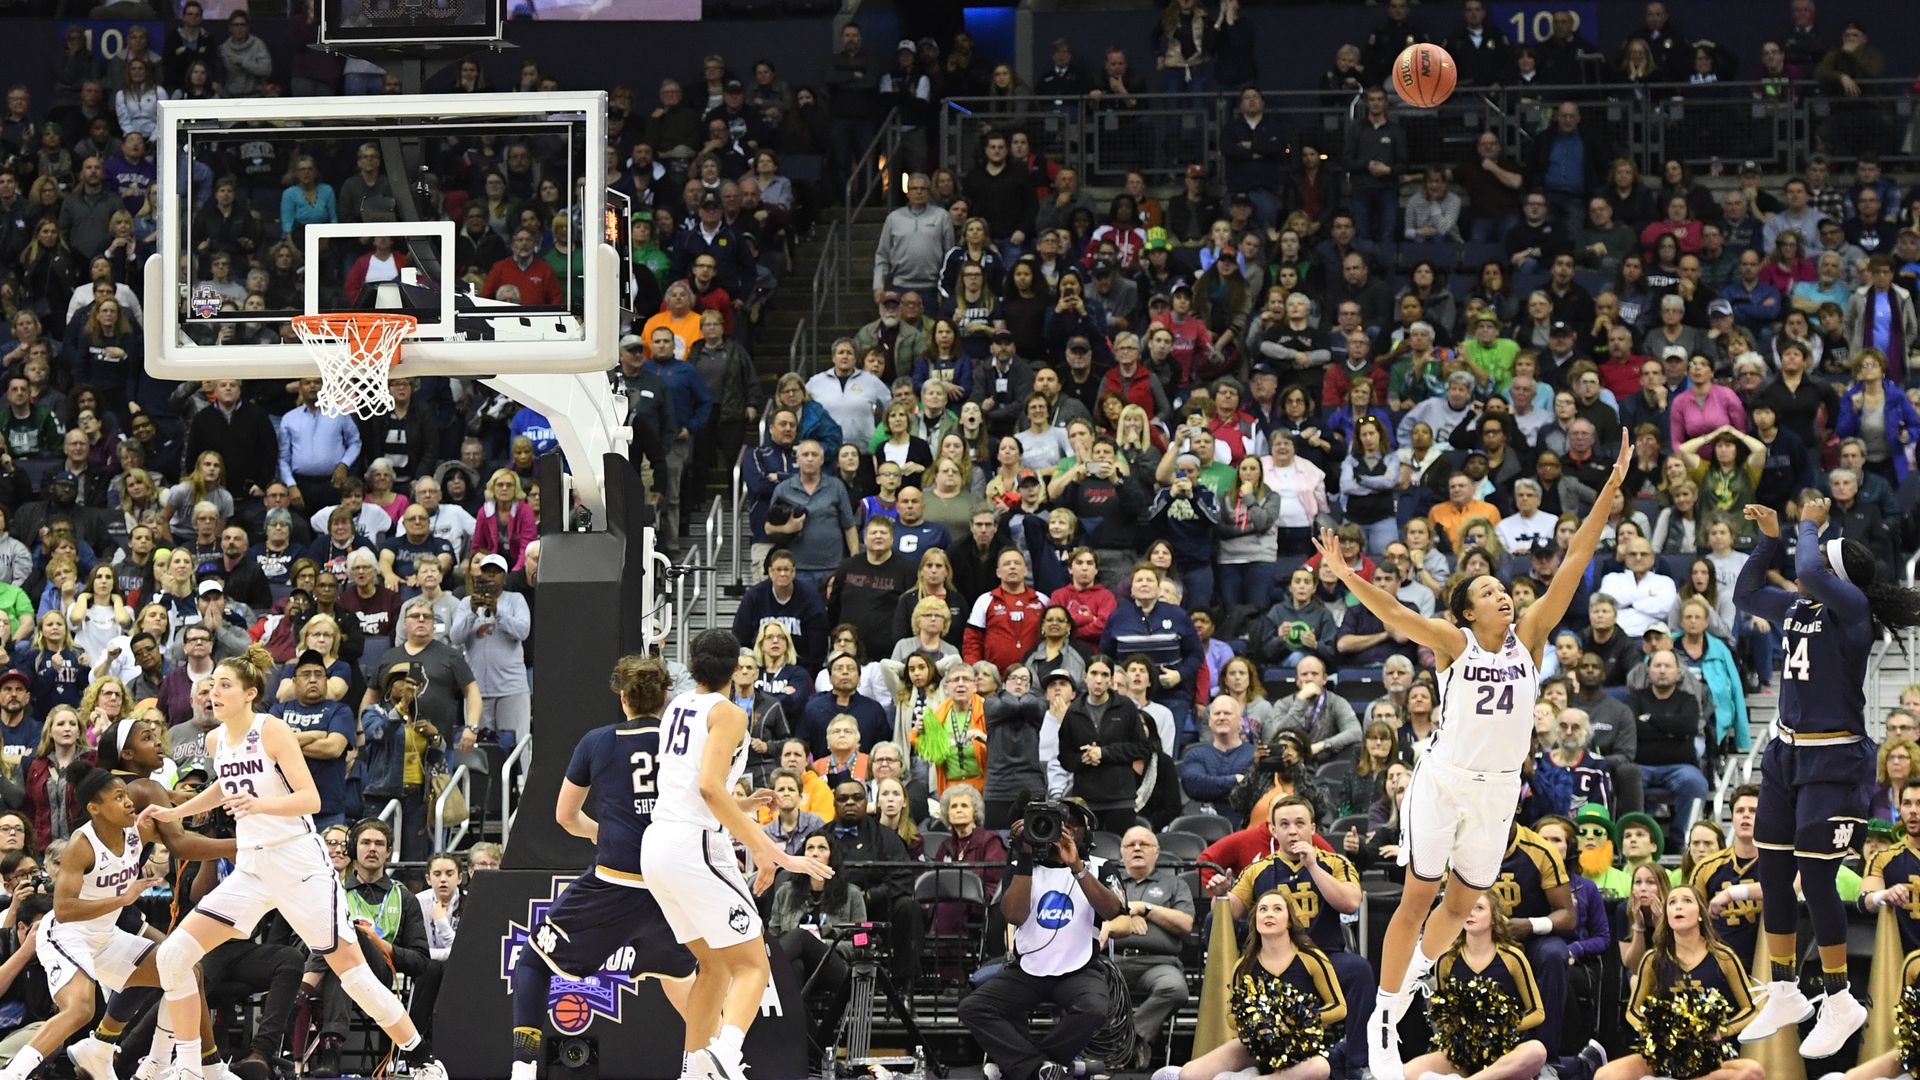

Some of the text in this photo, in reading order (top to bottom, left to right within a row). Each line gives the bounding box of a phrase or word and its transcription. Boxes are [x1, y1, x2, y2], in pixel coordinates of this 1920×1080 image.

[899, 534, 919, 553] C
[1791, 620, 1823, 634] DAME
[1463, 663, 1527, 684] UCONN
[1475, 684, 1515, 715] 24
[663, 707, 699, 757] 15
[629, 751, 661, 794] 2
[634, 798, 658, 815] SHE
[1037, 908, 1073, 921] NCAA
